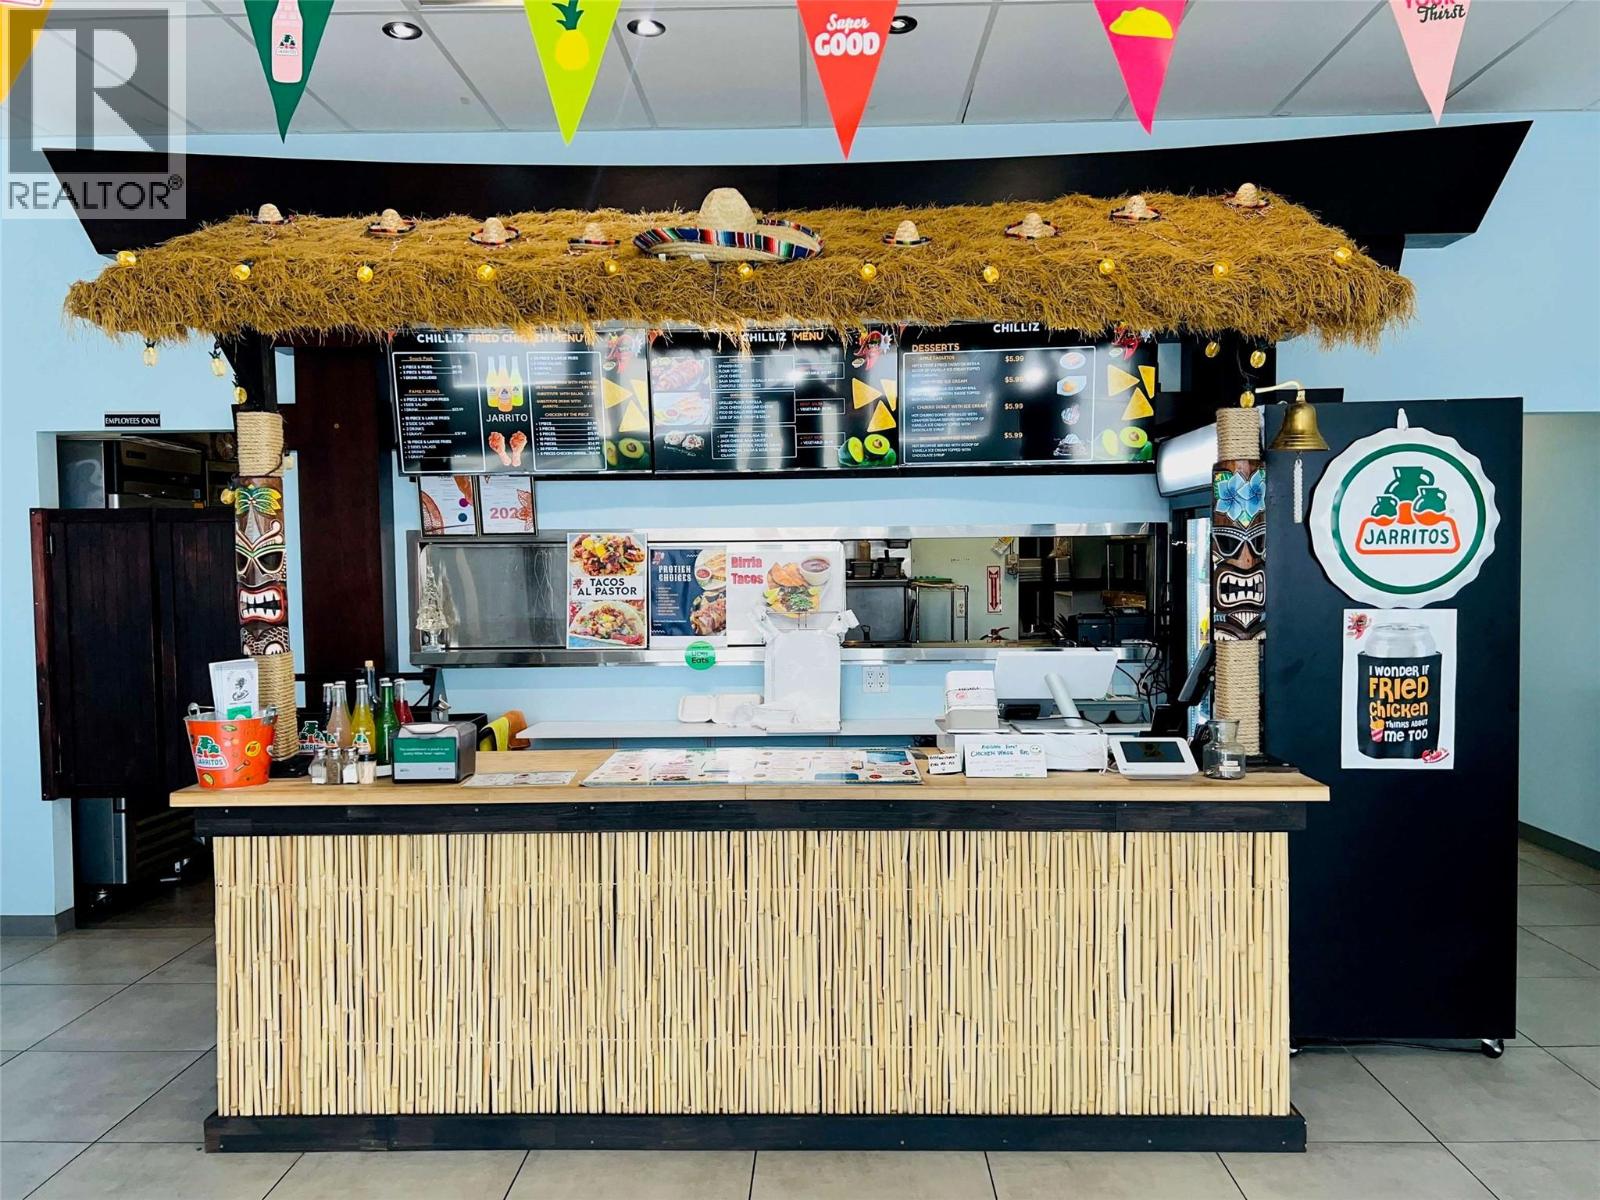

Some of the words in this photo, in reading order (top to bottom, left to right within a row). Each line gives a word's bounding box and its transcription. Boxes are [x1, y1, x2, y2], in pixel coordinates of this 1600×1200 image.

[1417, 4, 1466, 23] Thirst
[826, 13, 870, 34] Super
[814, 32, 880, 56] GOOD
[993, 322, 1040, 333] CHILLIZ
[416, 333, 464, 343] CHILLIZ
[468, 334, 499, 343] FRIED
[502, 333, 548, 343] CHICEN
[554, 334, 586, 343] MENU
[793, 332, 824, 341] MENU
[911, 343, 960, 352] DESSERTS
[1005, 355, 1024, 363] $5.99
[1005, 376, 1024, 384] $5.99
[1004, 402, 1024, 410] $5.99
[105, 417, 140, 425] EMPLOYEES
[486, 413, 528, 422] JARRITO
[490, 507, 520, 519] 202
[1364, 529, 1450, 544] JARRITOS
[731, 556, 763, 568] Birria
[590, 578, 625, 587] TACOS
[658, 573, 692, 582] CHOICES
[731, 573, 764, 585] Tacos
[577, 587, 592, 596] AL
[595, 587, 637, 596] PASTOR
[1369, 665, 1373, 676] I
[1422, 665, 1430, 675] IF
[1408, 728, 1428, 742] TOO
